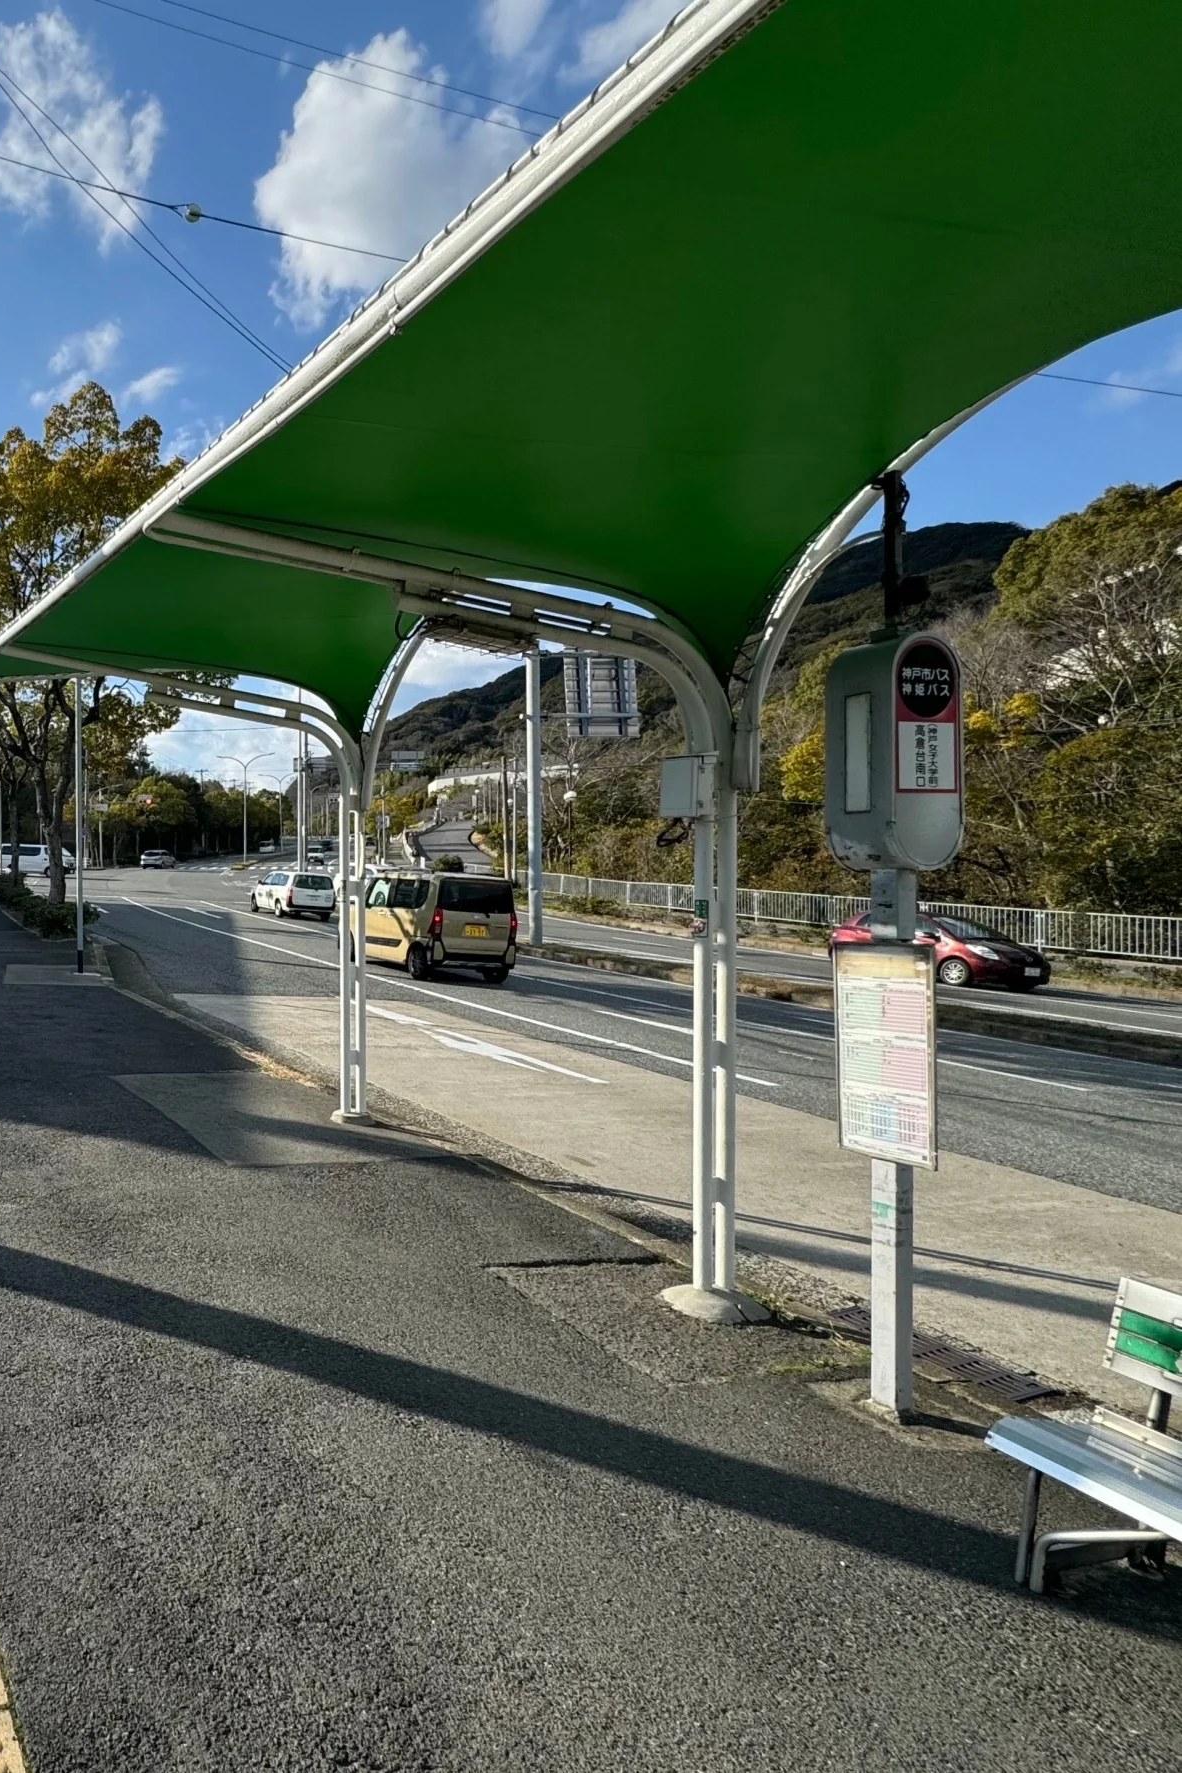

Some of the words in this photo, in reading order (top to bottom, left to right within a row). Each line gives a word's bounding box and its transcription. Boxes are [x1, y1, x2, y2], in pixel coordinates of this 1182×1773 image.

[901, 667, 950, 682] 神戸市バス
[901, 682, 950, 697] 神姫バス
[915, 724, 926, 787] 高倉台南口
